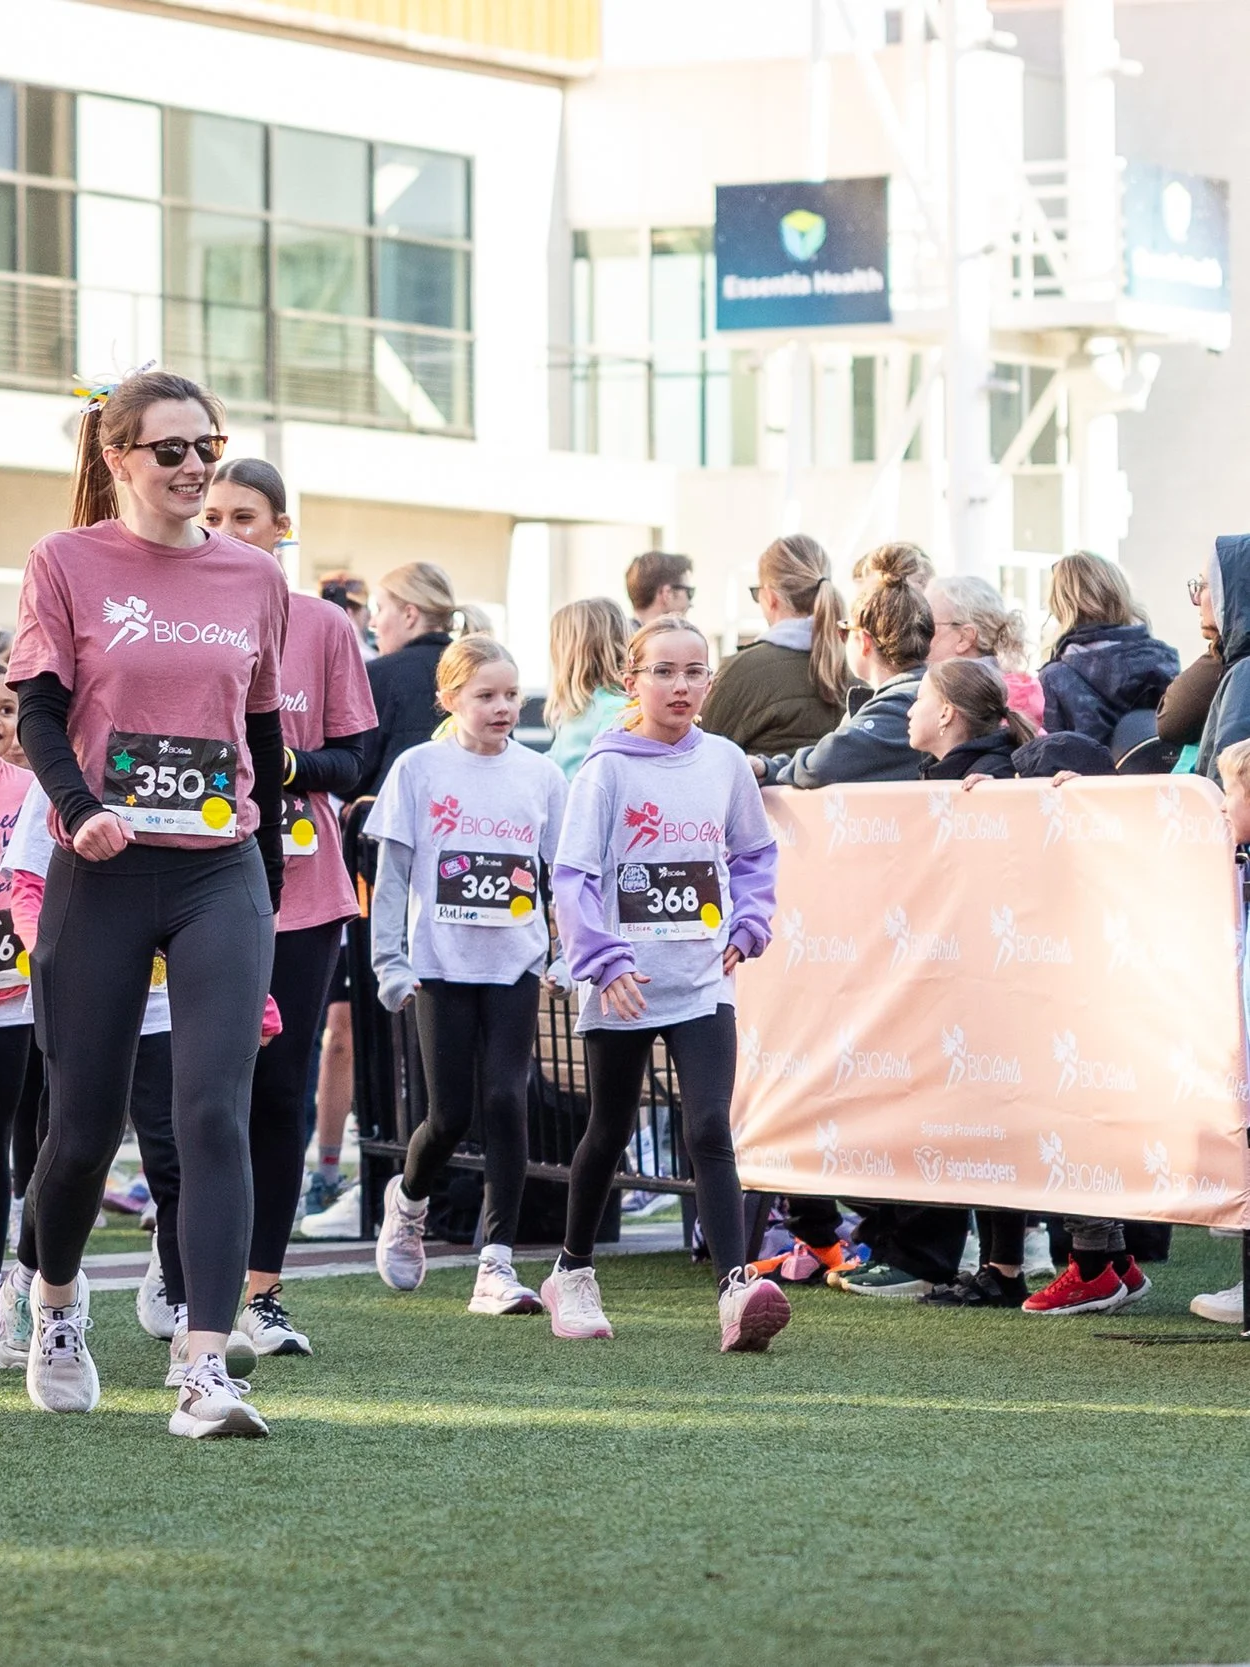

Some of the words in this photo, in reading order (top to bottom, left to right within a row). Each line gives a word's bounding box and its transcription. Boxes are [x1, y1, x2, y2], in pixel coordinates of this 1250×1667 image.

[154, 620, 251, 650] BIOGirls
[134, 764, 205, 800] 350
[461, 816, 534, 844] BIOGirls
[847, 815, 901, 844] BIOGirls
[955, 812, 1009, 841] BIOGirls
[461, 874, 511, 901] 362
[646, 886, 700, 914] 368
[805, 936, 857, 962] BIOGirls
[910, 935, 961, 961] BIOGirls
[1016, 935, 1072, 965] BIOGirls
[855, 1051, 913, 1080] BIOGirls
[966, 1052, 1022, 1084] BIOGirls
[1079, 1060, 1138, 1093] BIOGirls
[920, 1120, 953, 1137] Signage
[955, 1122, 991, 1138] Provided
[993, 1124, 1007, 1141] By:
[838, 1148, 895, 1177] BIOGirls
[945, 1155, 1017, 1184] signbadgers
[1067, 1162, 1125, 1196] BIOGirls
